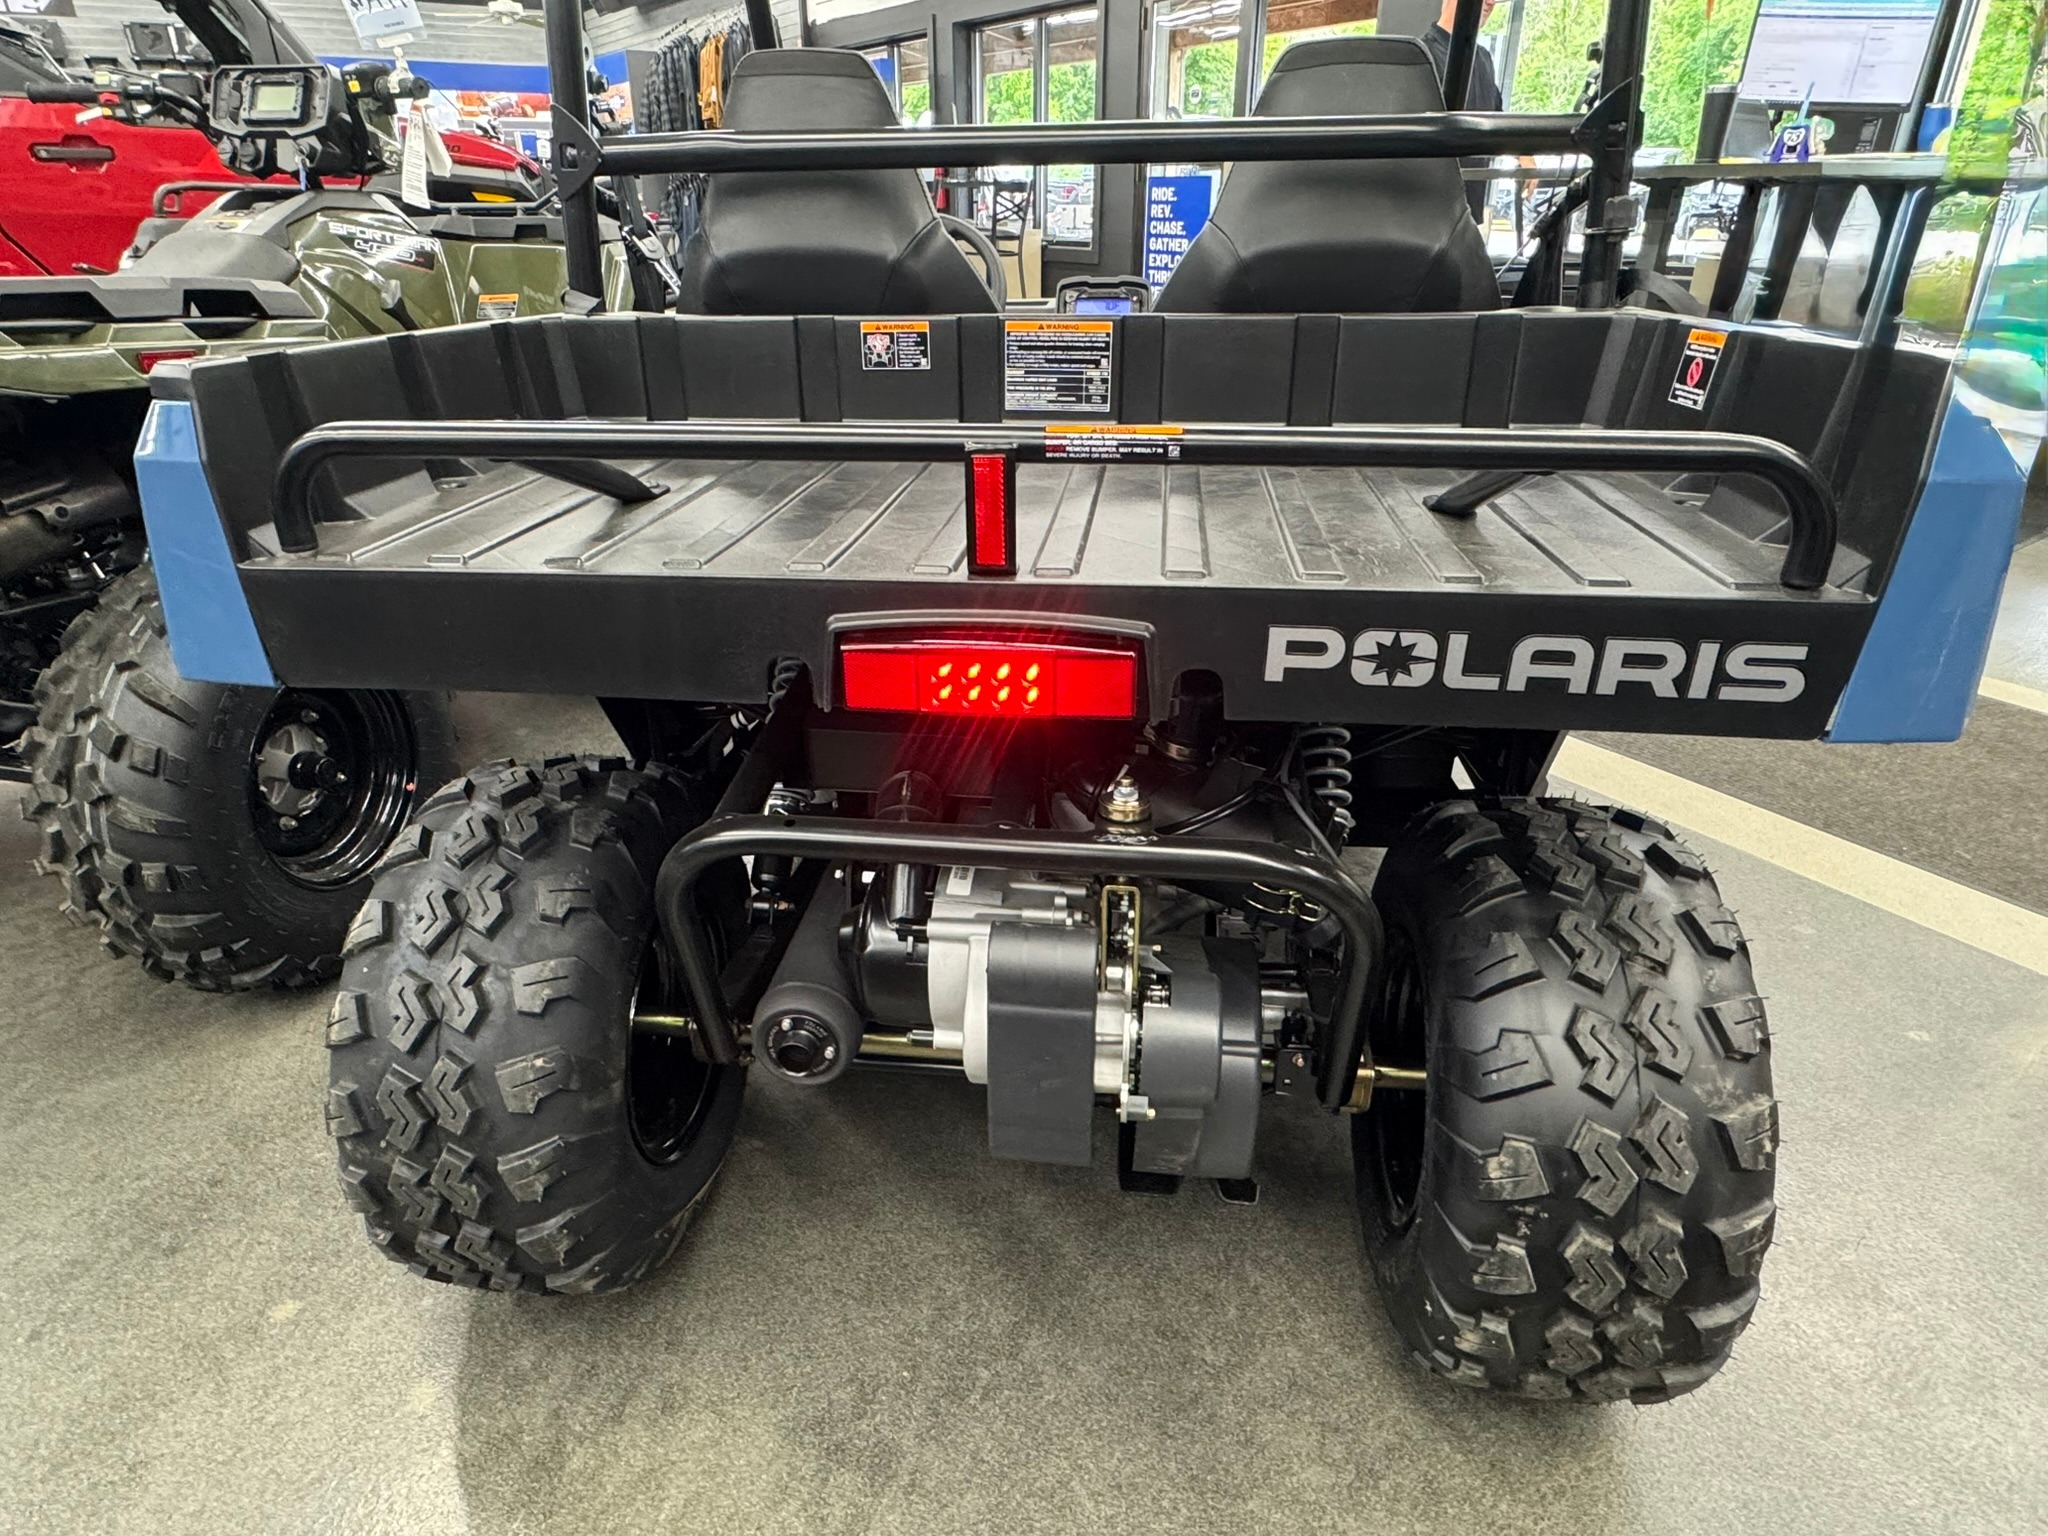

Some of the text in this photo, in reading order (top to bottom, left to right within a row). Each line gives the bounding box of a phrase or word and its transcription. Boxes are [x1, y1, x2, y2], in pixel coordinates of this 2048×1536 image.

[1151, 186, 1177, 201] RIDE.
[1150, 204, 1173, 218] REV.
[1149, 220, 1186, 235] CHASE.
[1148, 237, 1189, 252] GATHER
[1263, 625, 1811, 703] POLARIS
